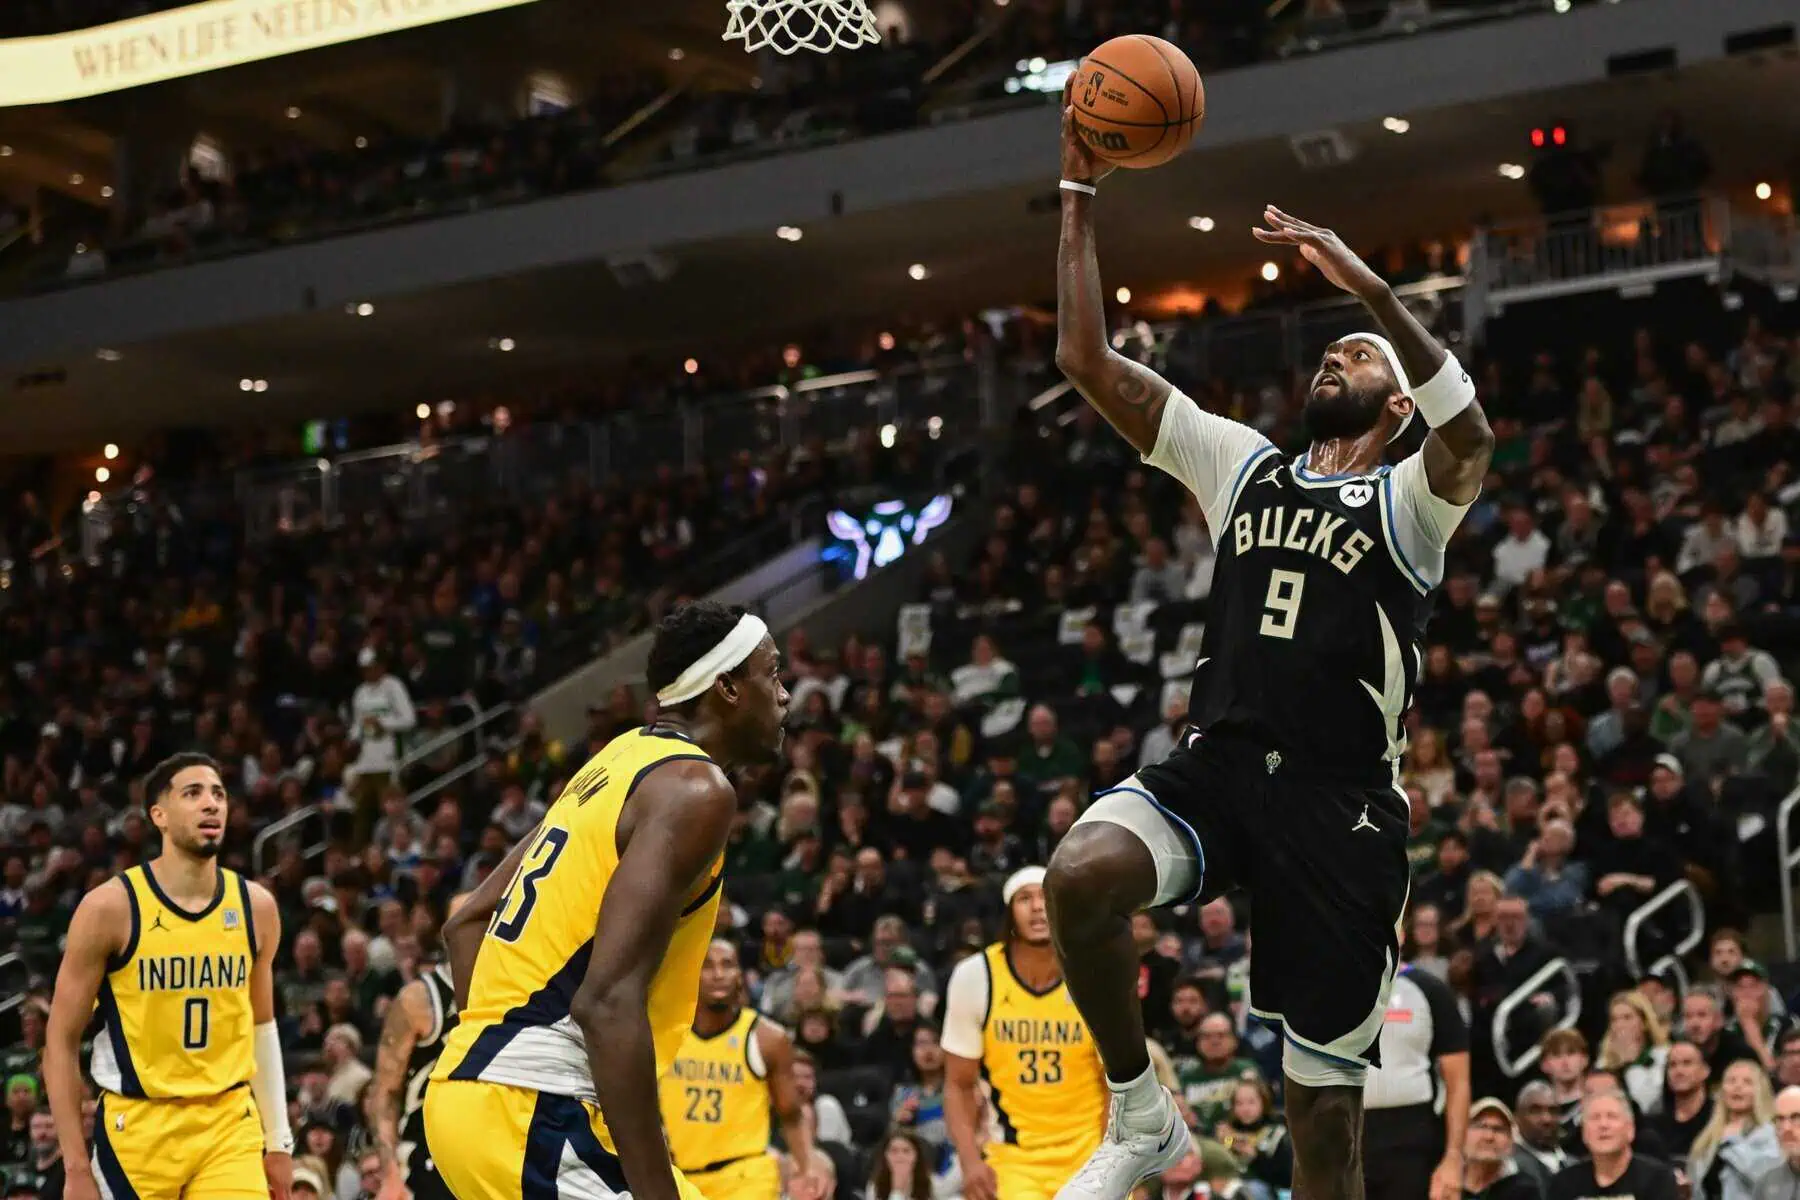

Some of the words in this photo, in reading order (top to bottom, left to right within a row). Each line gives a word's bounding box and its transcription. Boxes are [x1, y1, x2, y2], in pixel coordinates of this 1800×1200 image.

[72, 32, 169, 80] WHEN
[177, 14, 236, 64] LIFE
[1234, 506, 1375, 575] BUCKS
[1259, 568, 1305, 639] 9
[138, 955, 246, 991] INDIANA
[184, 997, 209, 1049] 0
[994, 1019, 1083, 1044] INDIANA
[672, 1057, 745, 1084] NDIANA
[1018, 1050, 1062, 1084] 33
[686, 1087, 723, 1122] 23
